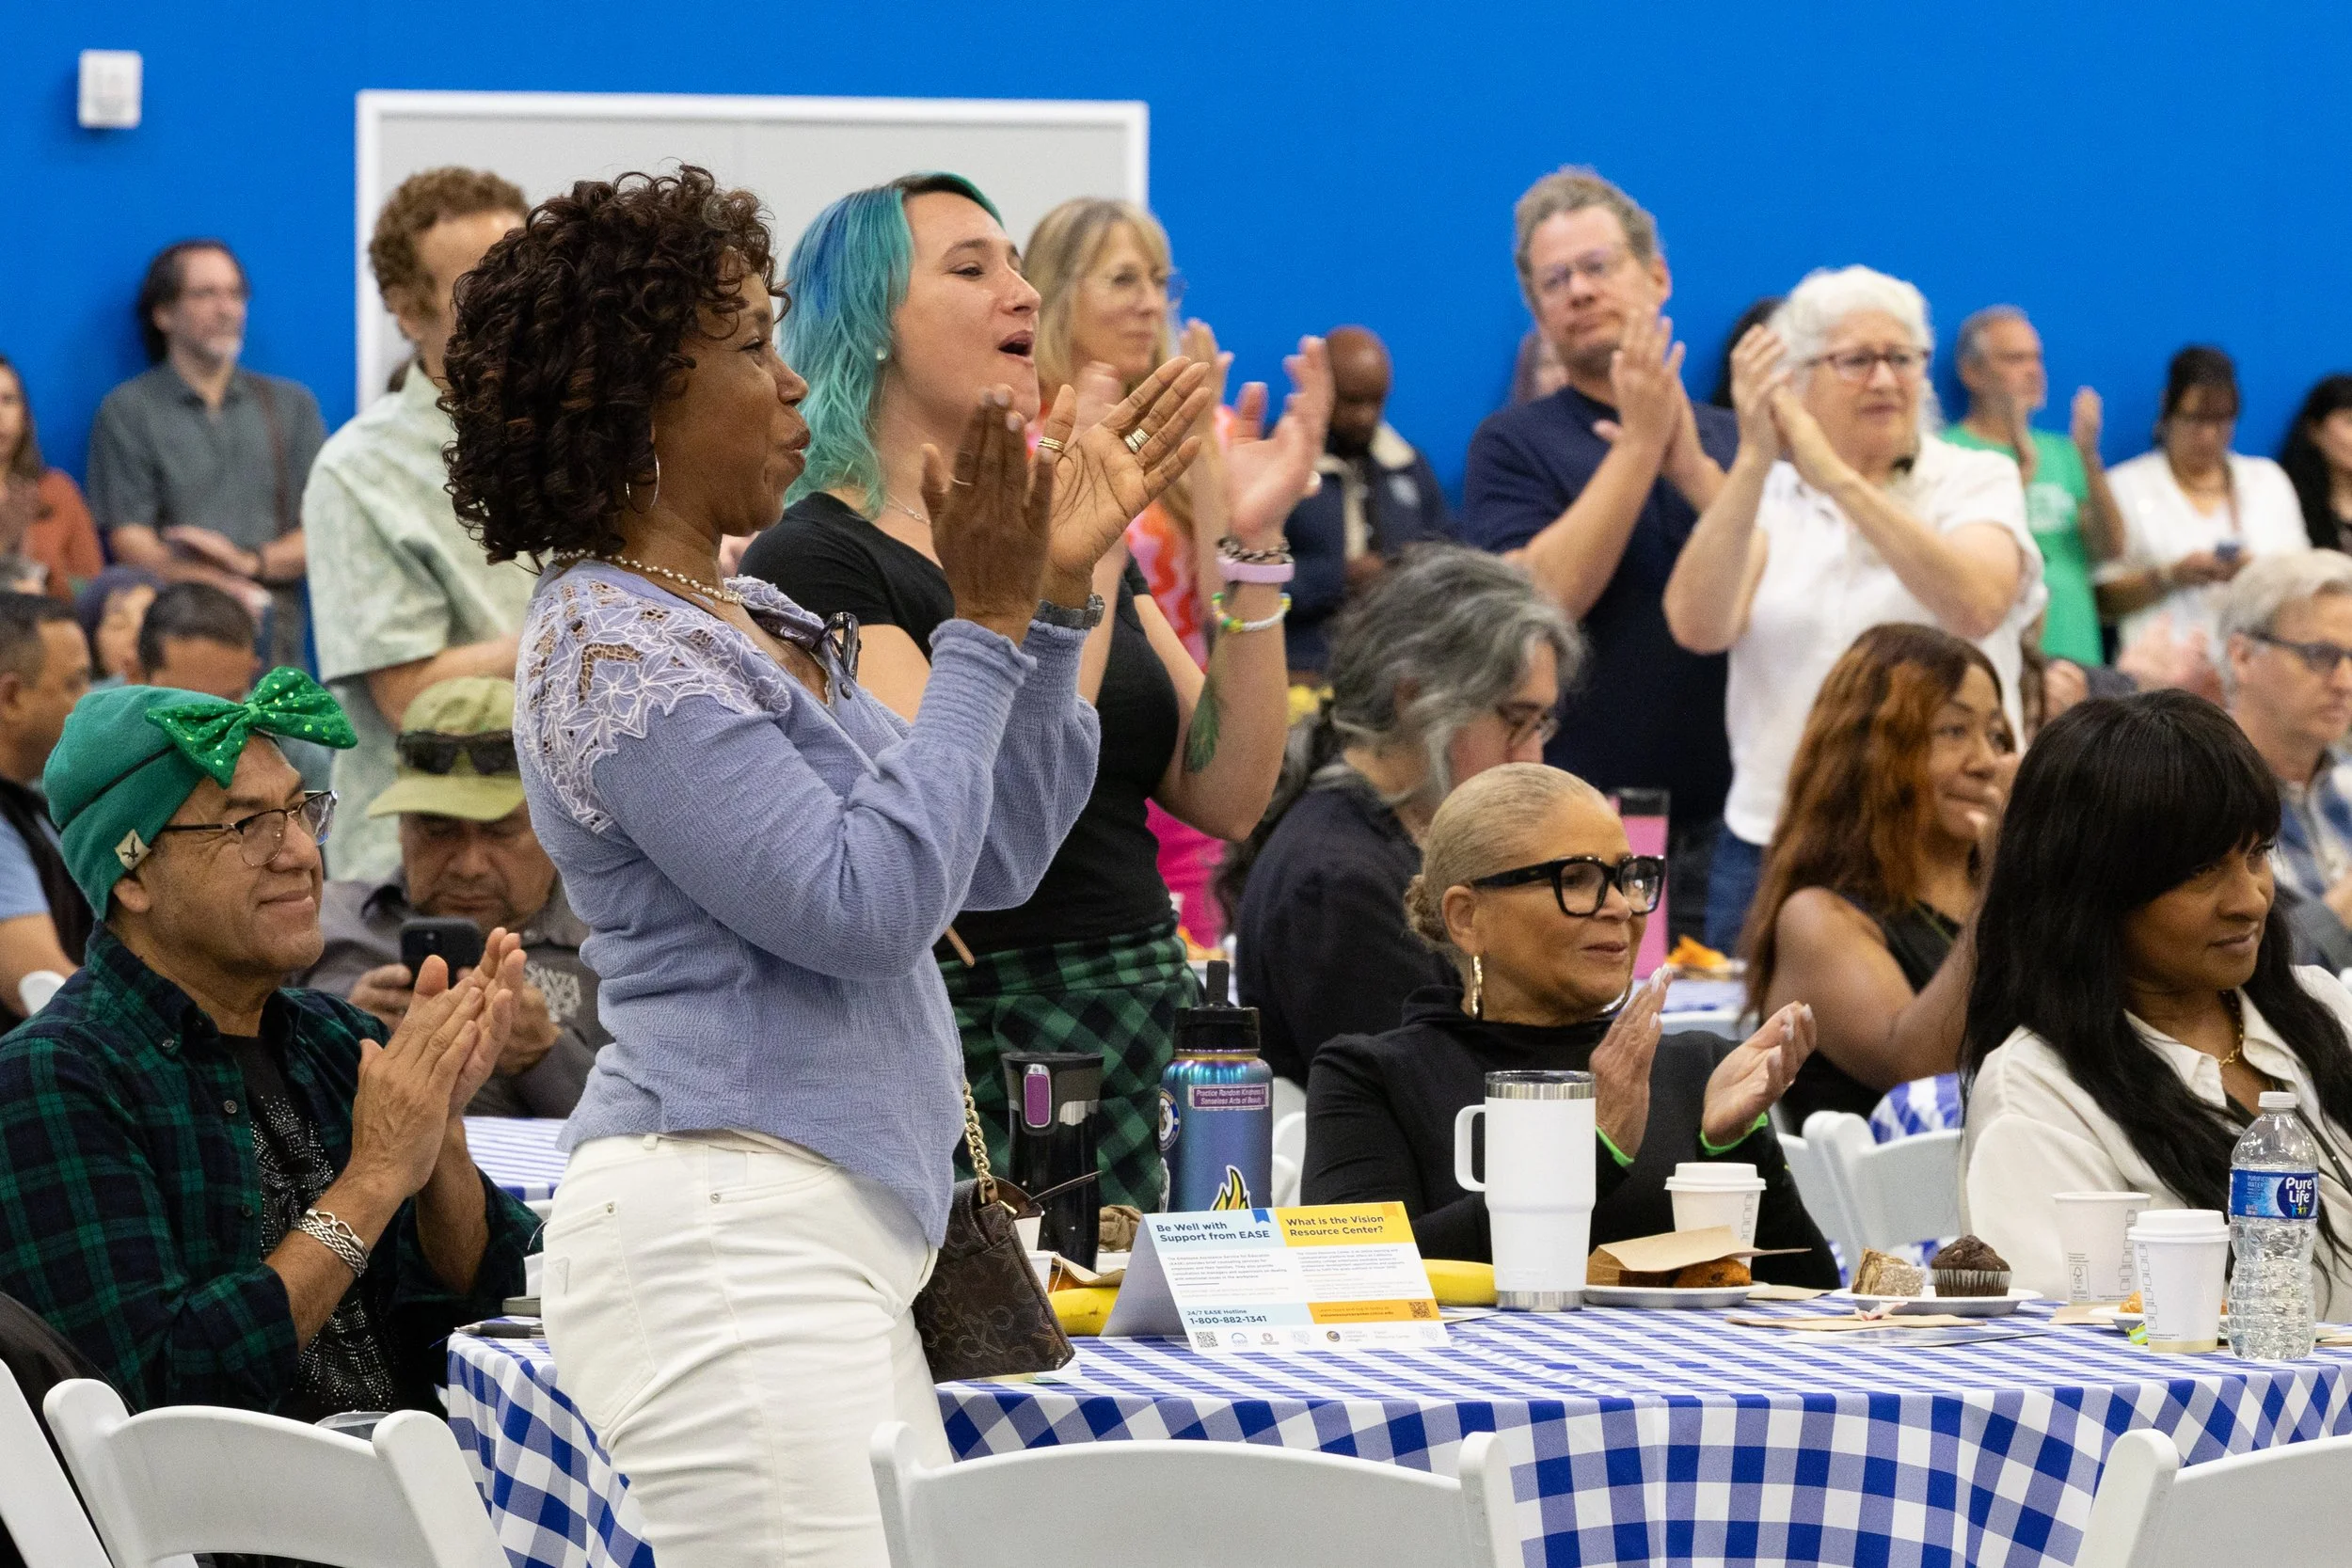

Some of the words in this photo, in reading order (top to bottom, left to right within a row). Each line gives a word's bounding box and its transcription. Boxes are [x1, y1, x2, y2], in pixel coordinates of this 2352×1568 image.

[2285, 1177, 2312, 1190] Pure
[2289, 1190, 2310, 1207] Life
[1156, 1224, 1171, 1232] Be
[1173, 1223, 1200, 1231] Well
[1201, 1222, 1228, 1230] with
[1285, 1218, 1315, 1227] What
[1329, 1216, 1348, 1225] the
[1350, 1215, 1384, 1224] Vision
[1160, 1233, 1207, 1243] Support
[1209, 1232, 1237, 1241] from
[1239, 1230, 1270, 1239] EASE
[1289, 1227, 1340, 1237] Resource
[1342, 1226, 1384, 1234] Center?
[1189, 1315, 1267, 1325] 1-800-882-1341
